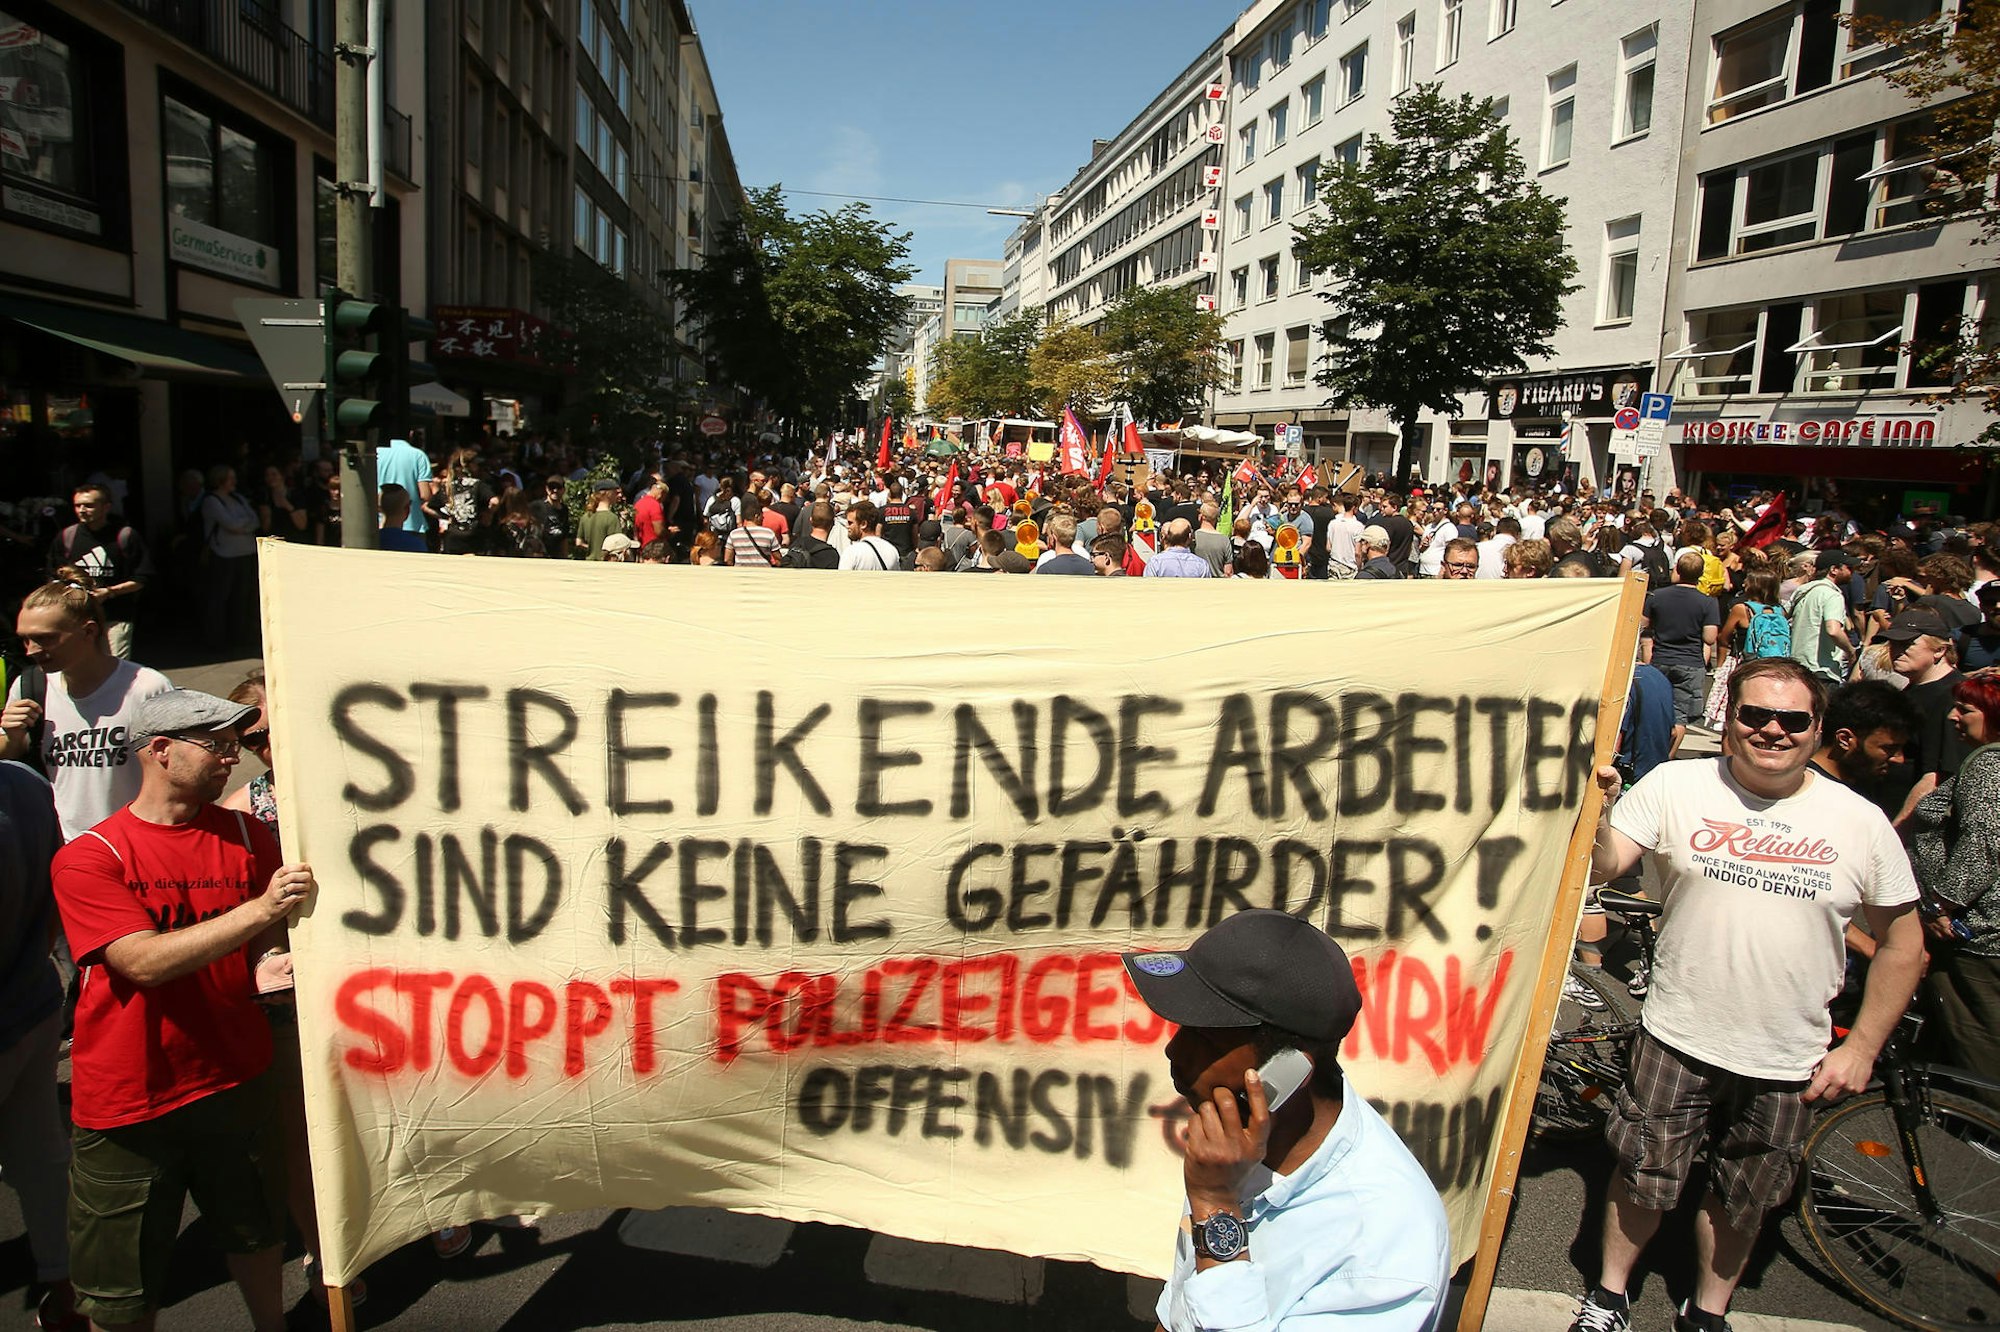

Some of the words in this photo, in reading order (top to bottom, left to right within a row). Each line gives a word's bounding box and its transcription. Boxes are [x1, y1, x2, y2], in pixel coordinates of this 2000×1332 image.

[173, 228, 253, 267] GermaService
[1646, 396, 1666, 419] P
[1683, 421, 1755, 439] KIOSK
[1799, 415, 1877, 440] CAFÉ
[49, 726, 125, 753] ARCTIC
[329, 680, 1183, 823] STREIKENDE
[1197, 689, 1600, 822] ARBEITER
[1690, 817, 1839, 864] Reliable
[1746, 818, 1767, 828] EST.
[1770, 821, 1792, 834] 1975
[341, 823, 564, 945] SIND
[604, 832, 892, 949] KEINE
[1691, 854, 1720, 868] ONCE
[1722, 860, 1754, 875] TRIED
[1755, 869, 1800, 885] ALWAYS
[1803, 877, 1832, 891] USED
[1703, 866, 1758, 889] INDIGO
[1762, 880, 1817, 901] DENIM
[1791, 865, 1832, 881] VINTAGE
[333, 966, 681, 1079] STOPPT
[1344, 947, 1515, 1077] NRW
[799, 1063, 1150, 1169] OFFENSIV
